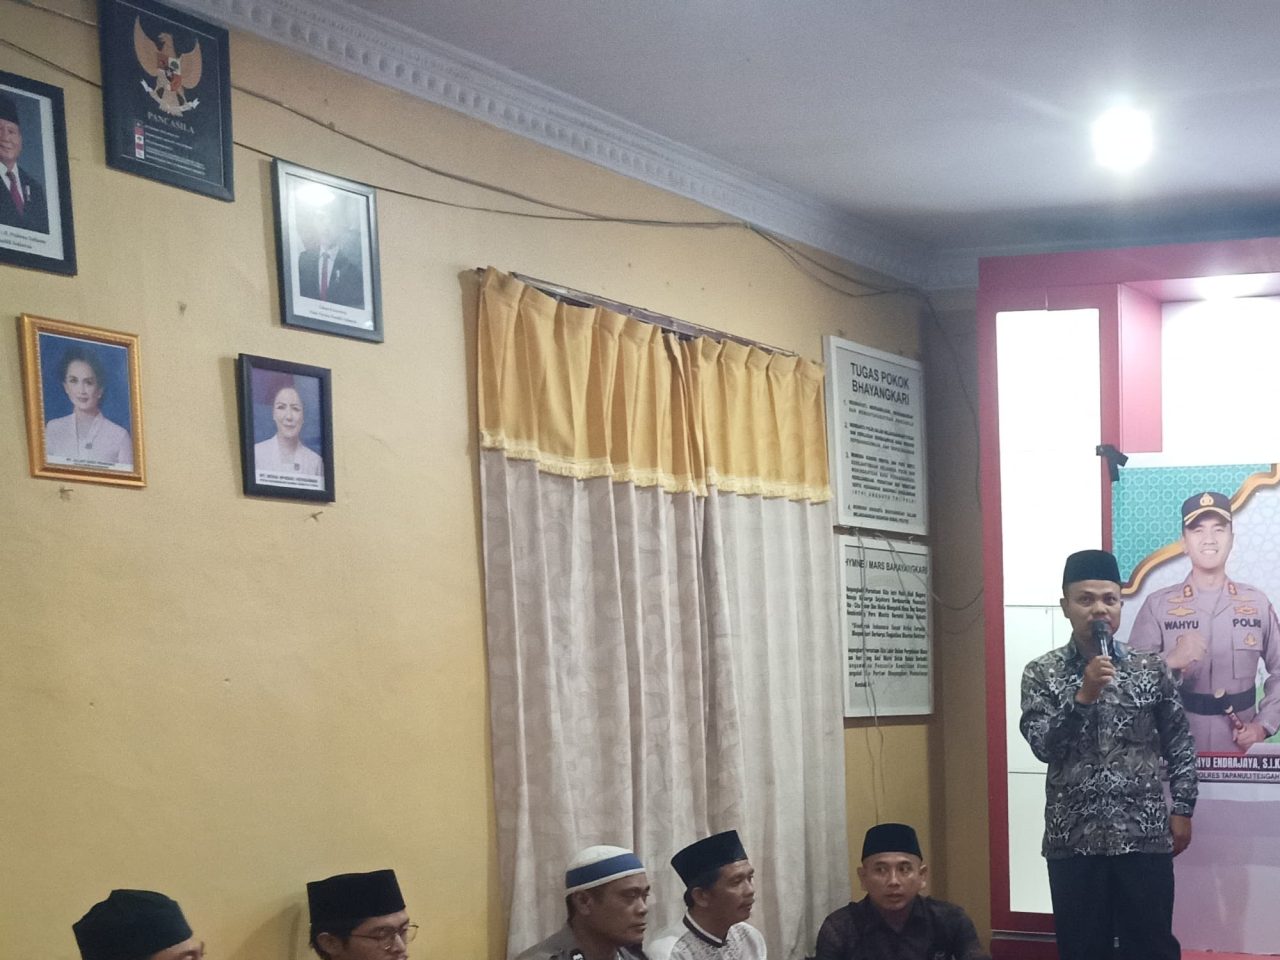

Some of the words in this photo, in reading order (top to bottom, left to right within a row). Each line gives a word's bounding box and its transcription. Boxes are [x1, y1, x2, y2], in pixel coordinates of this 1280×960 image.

[850, 362, 880, 382] TUGAS
[881, 370, 910, 389] POKOK
[851, 380, 910, 405] BHAYANGKARI
[1164, 620, 1200, 630] WAHYU
[1213, 757, 1260, 770] ENDRAJAYA,
